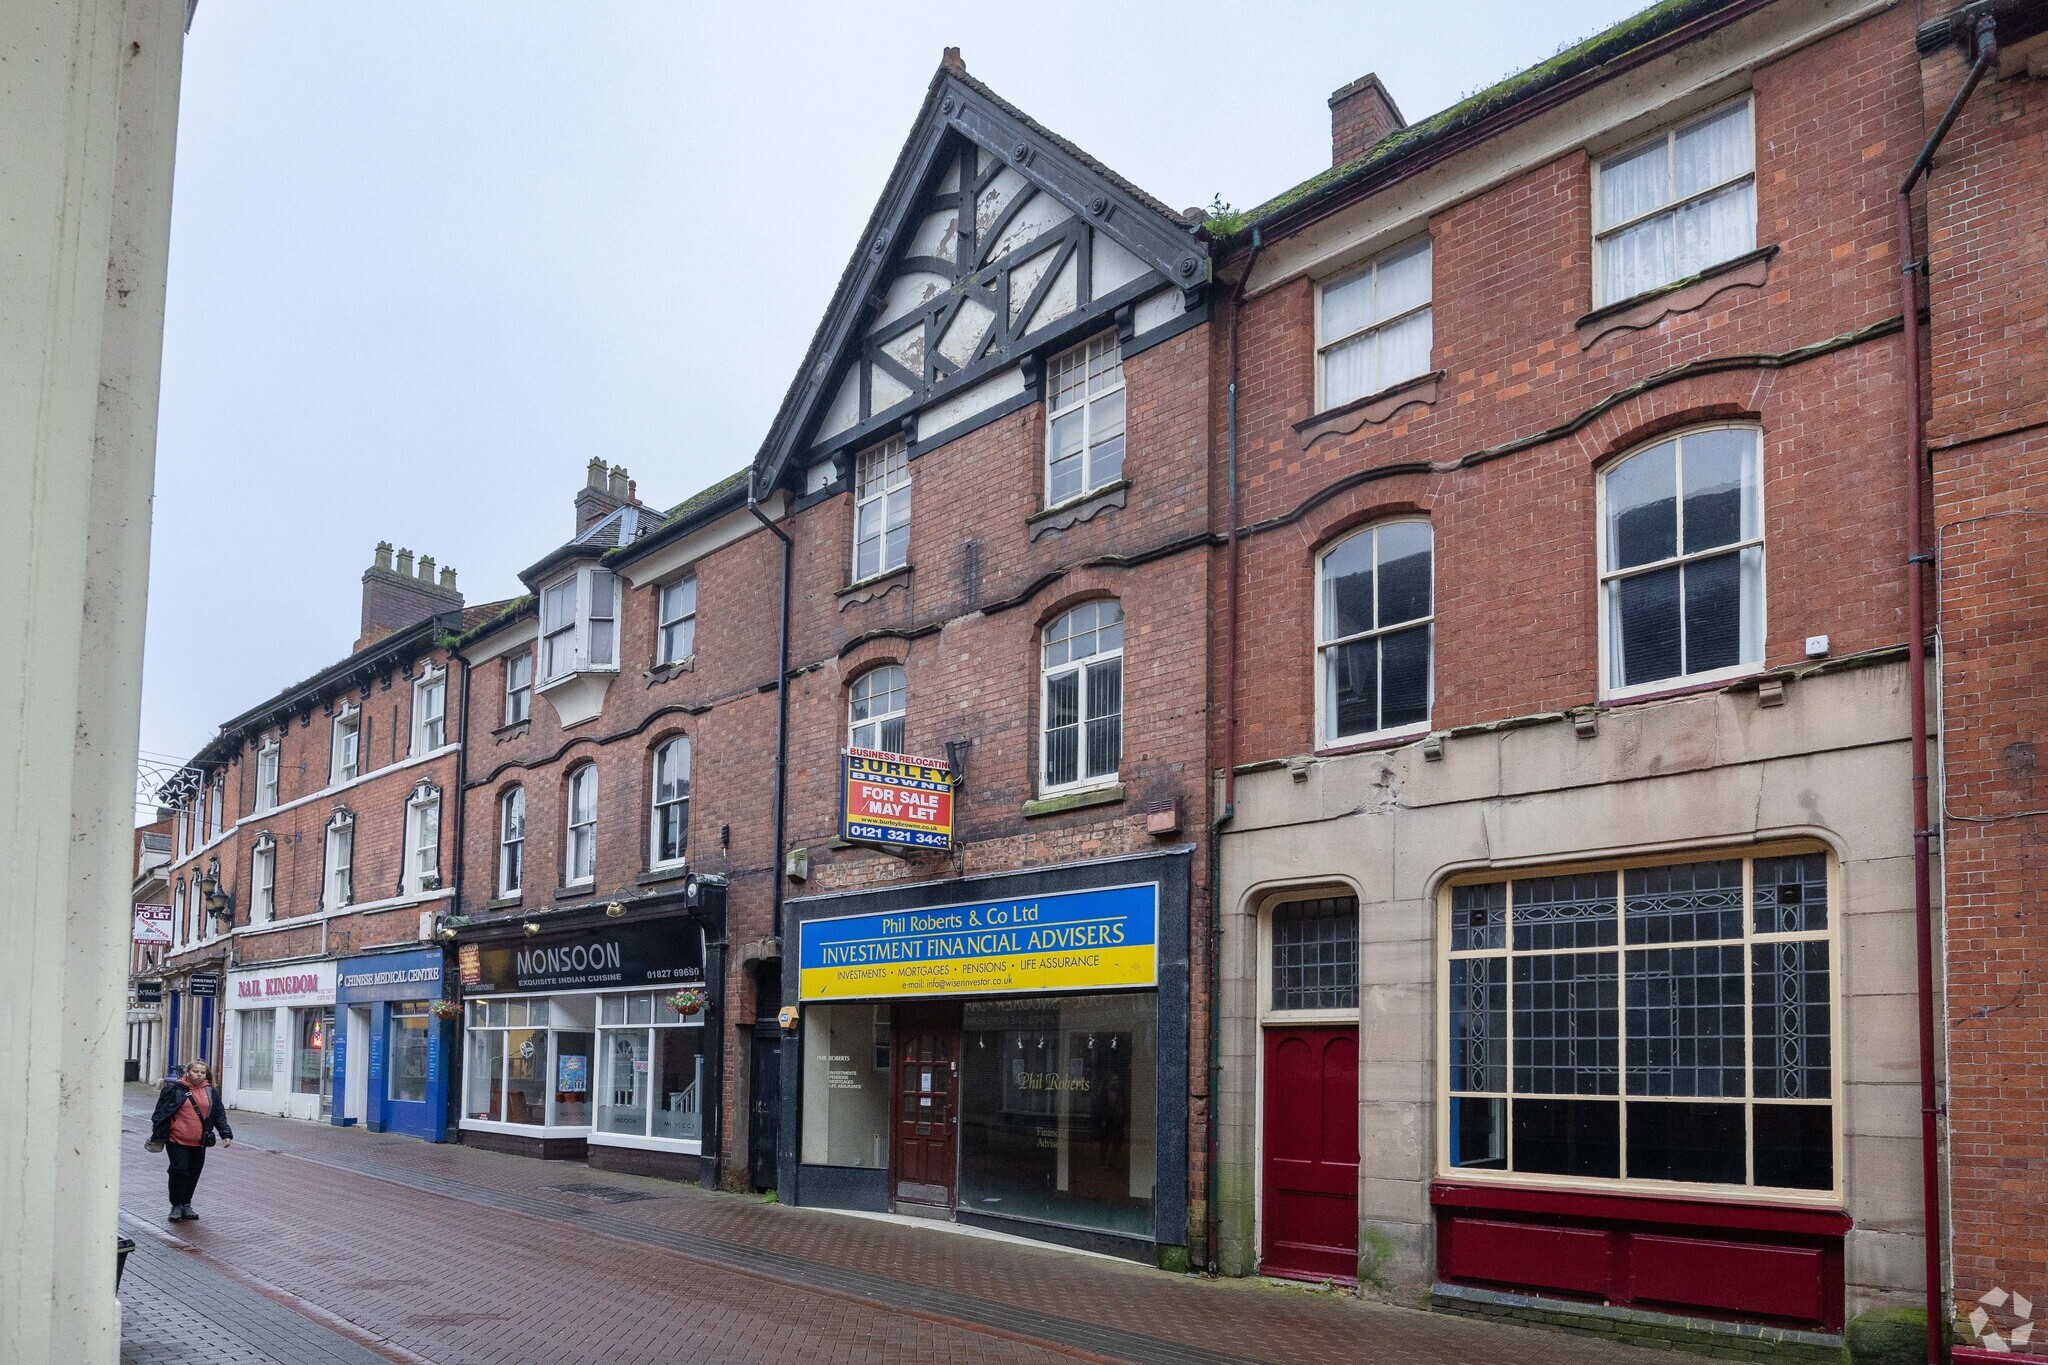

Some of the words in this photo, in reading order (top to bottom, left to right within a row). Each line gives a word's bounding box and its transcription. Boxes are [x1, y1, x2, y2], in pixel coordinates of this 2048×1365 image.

[850, 748, 896, 761] BUSINESS
[850, 757, 951, 782] BURLEY
[852, 772, 949, 791] BROWNE
[862, 786, 894, 801] FOR
[900, 791, 938, 808] SALE
[909, 807, 936, 820] LET
[851, 826, 882, 838] 0121
[888, 830, 910, 842] 321
[861, 818, 938, 831] www.burleybrowne.co.uk
[883, 917, 905, 934] Phil
[911, 913, 962, 932] Roberts
[969, 910, 982, 926] &
[987, 908, 1008, 925] Co
[1013, 904, 1039, 923] Ltd
[823, 940, 923, 964] INVESTMENT
[927, 933, 1022, 957] FINANCIAL
[1027, 923, 1125, 950] ADVISERS
[517, 942, 621, 975] MONSOON
[837, 968, 887, 980] INVESTMENTS
[898, 965, 950, 977] MORTGAGES
[962, 961, 1007, 974] PENSIONS
[1020, 958, 1036, 970] LIFE
[1039, 955, 1099, 969] ASSURANCE
[345, 973, 374, 987] CHINESE
[374, 970, 408, 985] MEDICAL
[408, 967, 439, 982] CENTRE
[518, 978, 557, 987] EXQUISITE
[558, 976, 586, 984] INDIAN
[587, 973, 622, 982] CUISINE
[647, 970, 671, 979] 01827
[927, 974, 1013, 989] info@wiserinvestor.co.uk
[238, 980, 262, 998] NAIL
[265, 974, 319, 996] KINGDOM
[1017, 1071, 1043, 1090] Phil
[1045, 1073, 1090, 1091] Roberts
